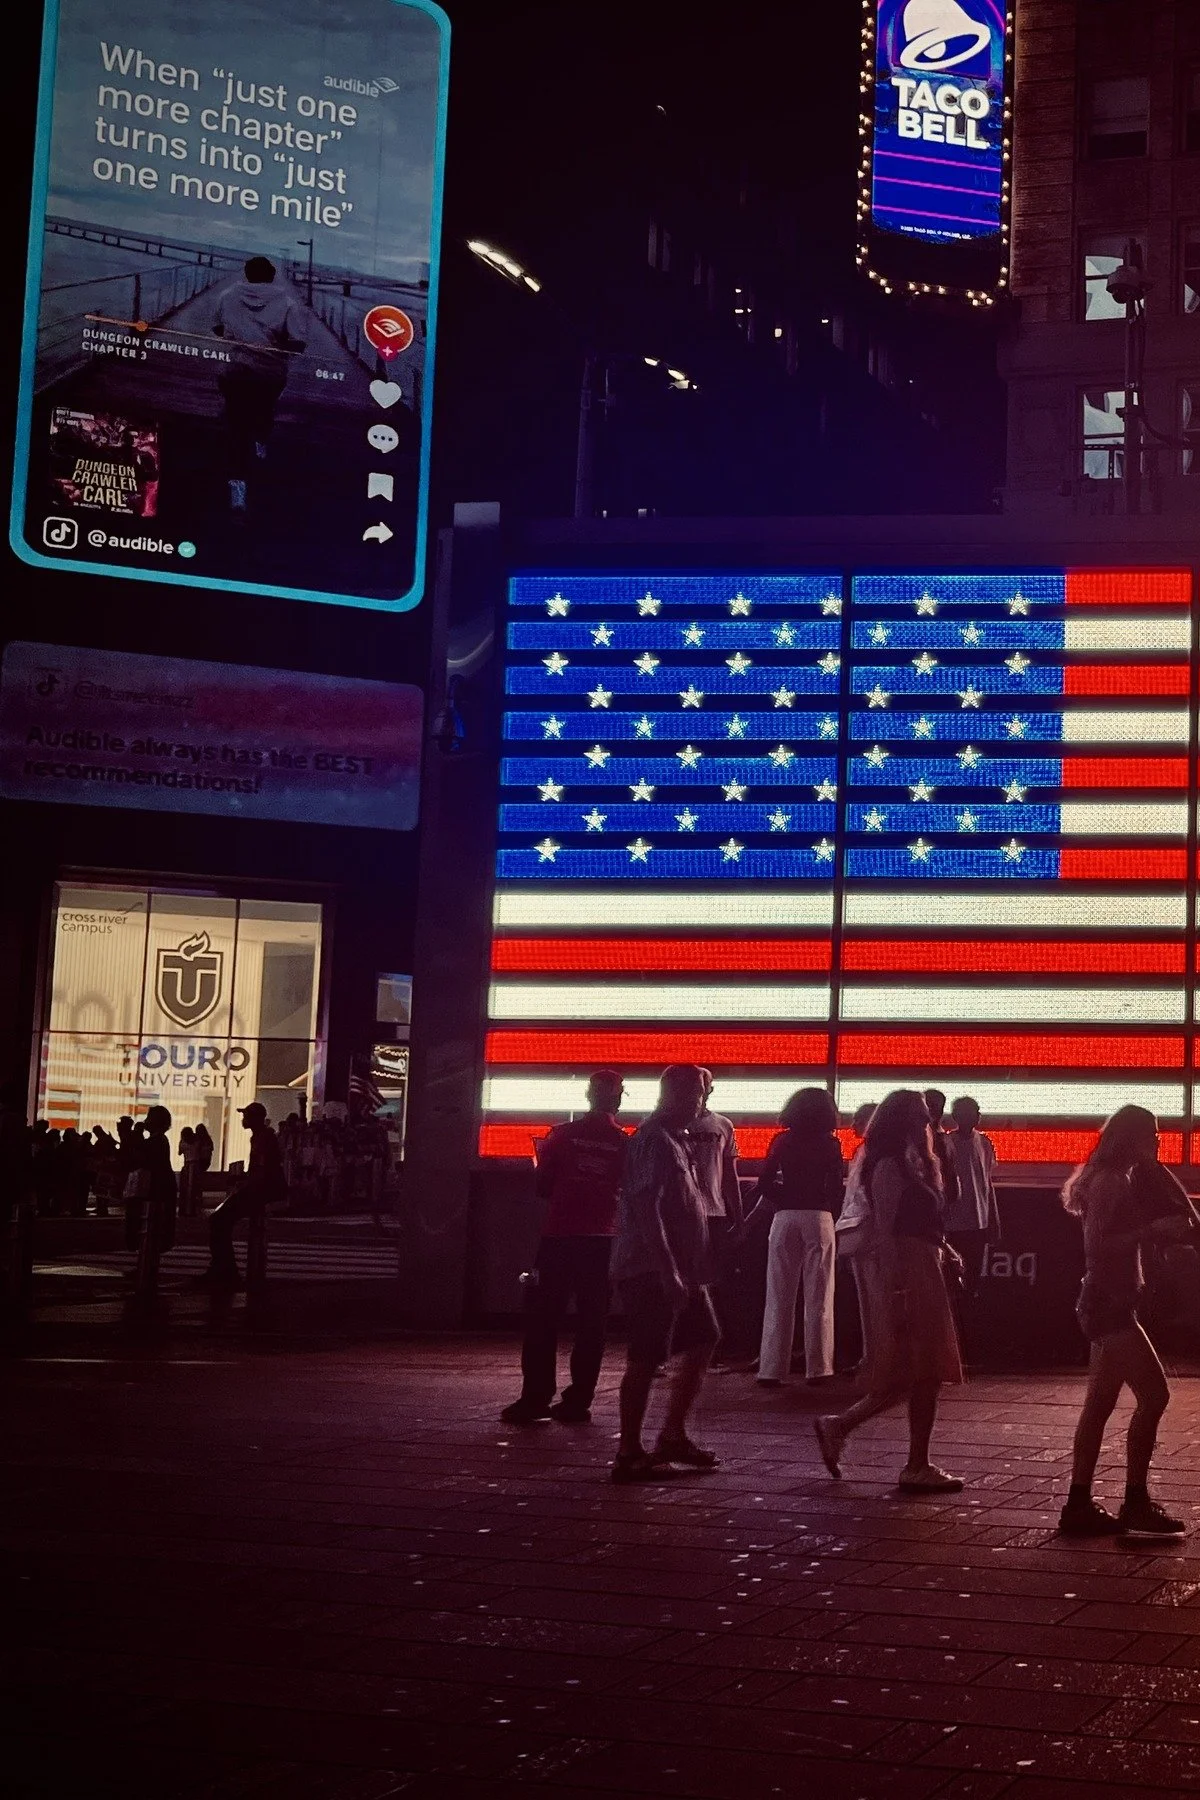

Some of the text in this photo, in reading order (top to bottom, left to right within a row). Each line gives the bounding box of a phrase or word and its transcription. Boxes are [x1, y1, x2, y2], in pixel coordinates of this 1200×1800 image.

[100, 41, 199, 91] When
[297, 95, 357, 126] one
[324, 74, 379, 98] audible
[98, 84, 190, 125] more
[891, 77, 991, 119] TACO
[897, 108, 990, 150] BELL
[95, 116, 188, 160] turns
[199, 138, 263, 176] into
[92, 157, 159, 189] one
[170, 172, 260, 211] more
[82, 328, 231, 362] DUNGEON CRAWLER CARL
[82, 341, 147, 361] CHAPTER 3
[72, 470, 138, 492] CRAWLER
[75, 458, 136, 478] DUNGEON
[82, 485, 127, 508] CARL
[87, 529, 175, 555] @audible
[26, 726, 375, 775] Audible always has the BEST
[23, 759, 264, 795] recommendations!
[61, 921, 113, 936] campus
[62, 912, 128, 926] cross river
[116, 1043, 251, 1071] TOURO
[118, 1072, 245, 1088] UNIVERSITY
